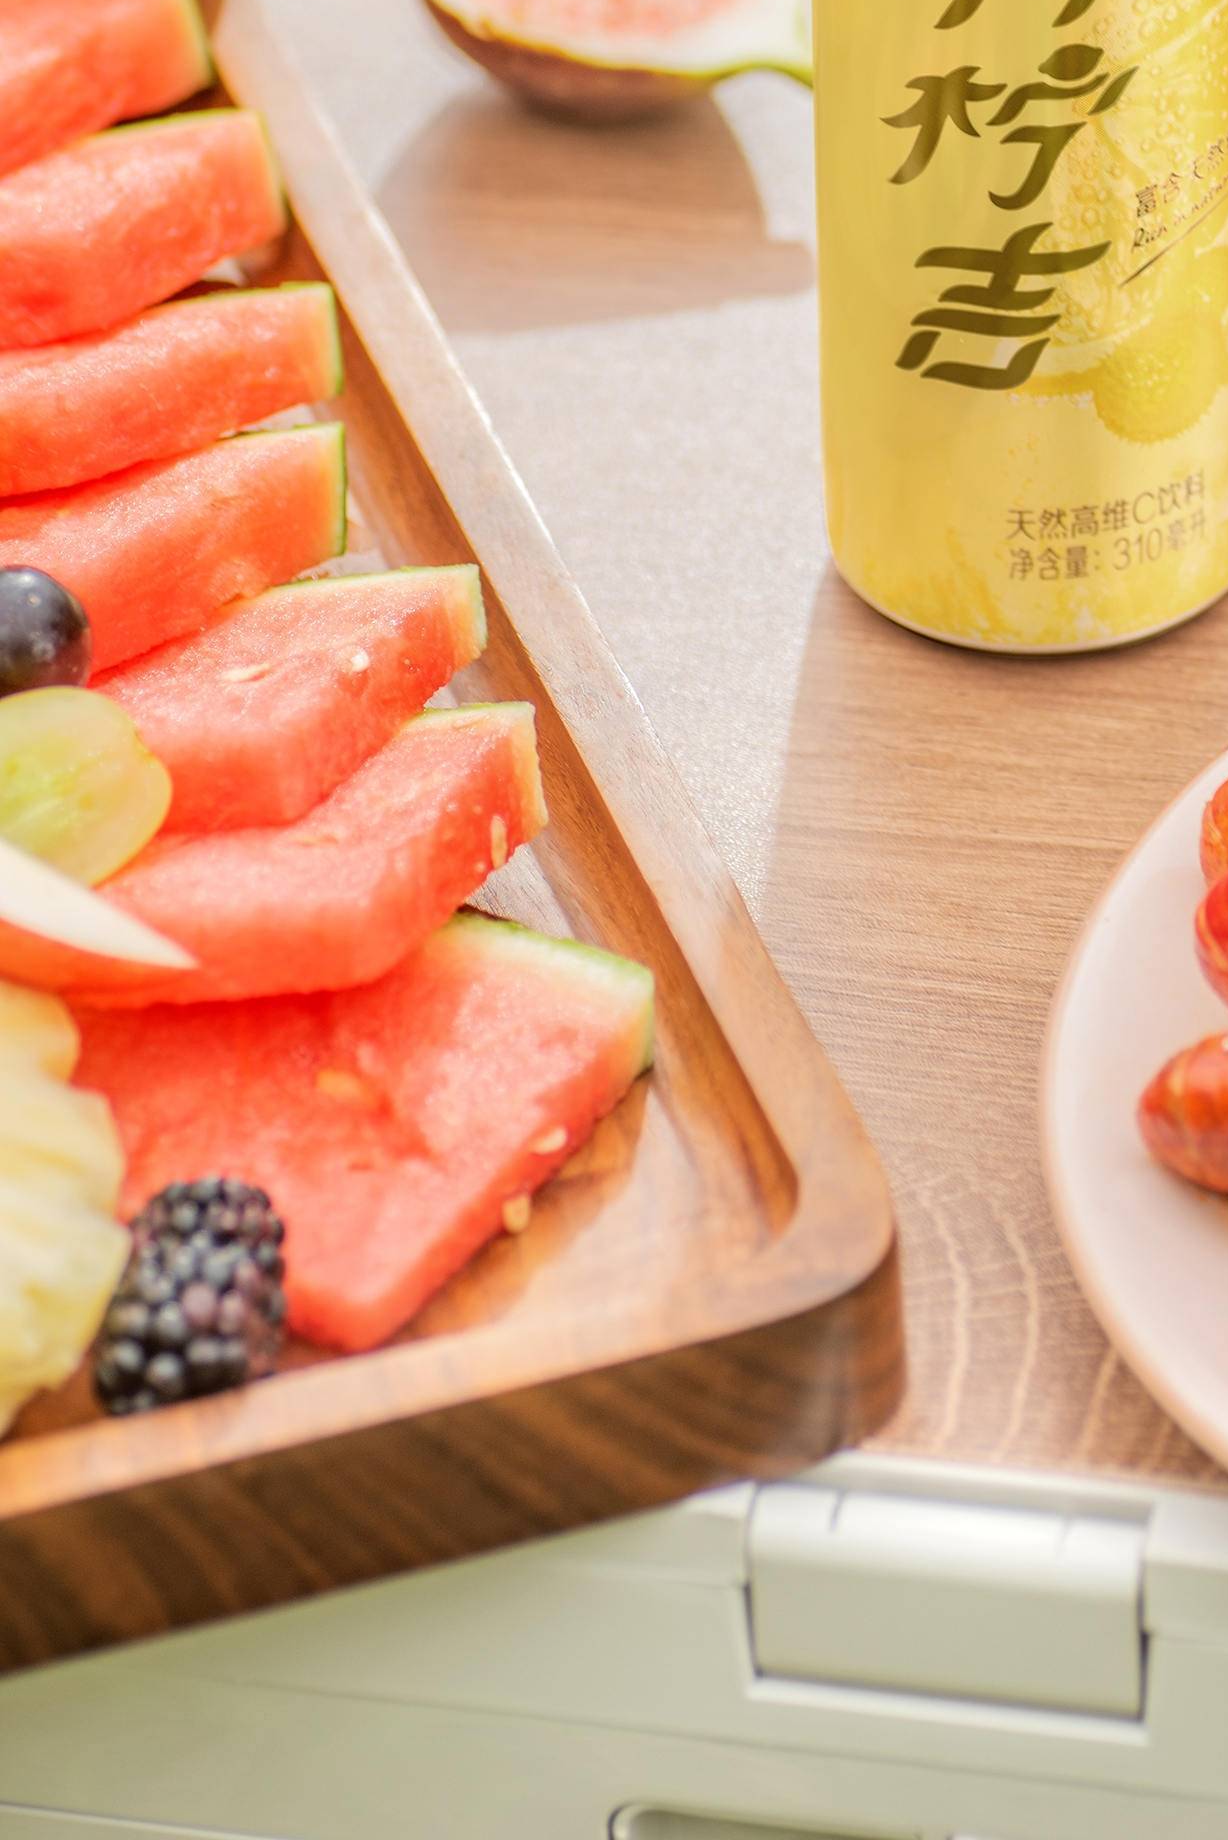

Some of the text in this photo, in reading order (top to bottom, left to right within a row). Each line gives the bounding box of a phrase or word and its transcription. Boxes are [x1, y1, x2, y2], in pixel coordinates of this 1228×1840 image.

[1006, 470, 1205, 541] 天然高维C饮料
